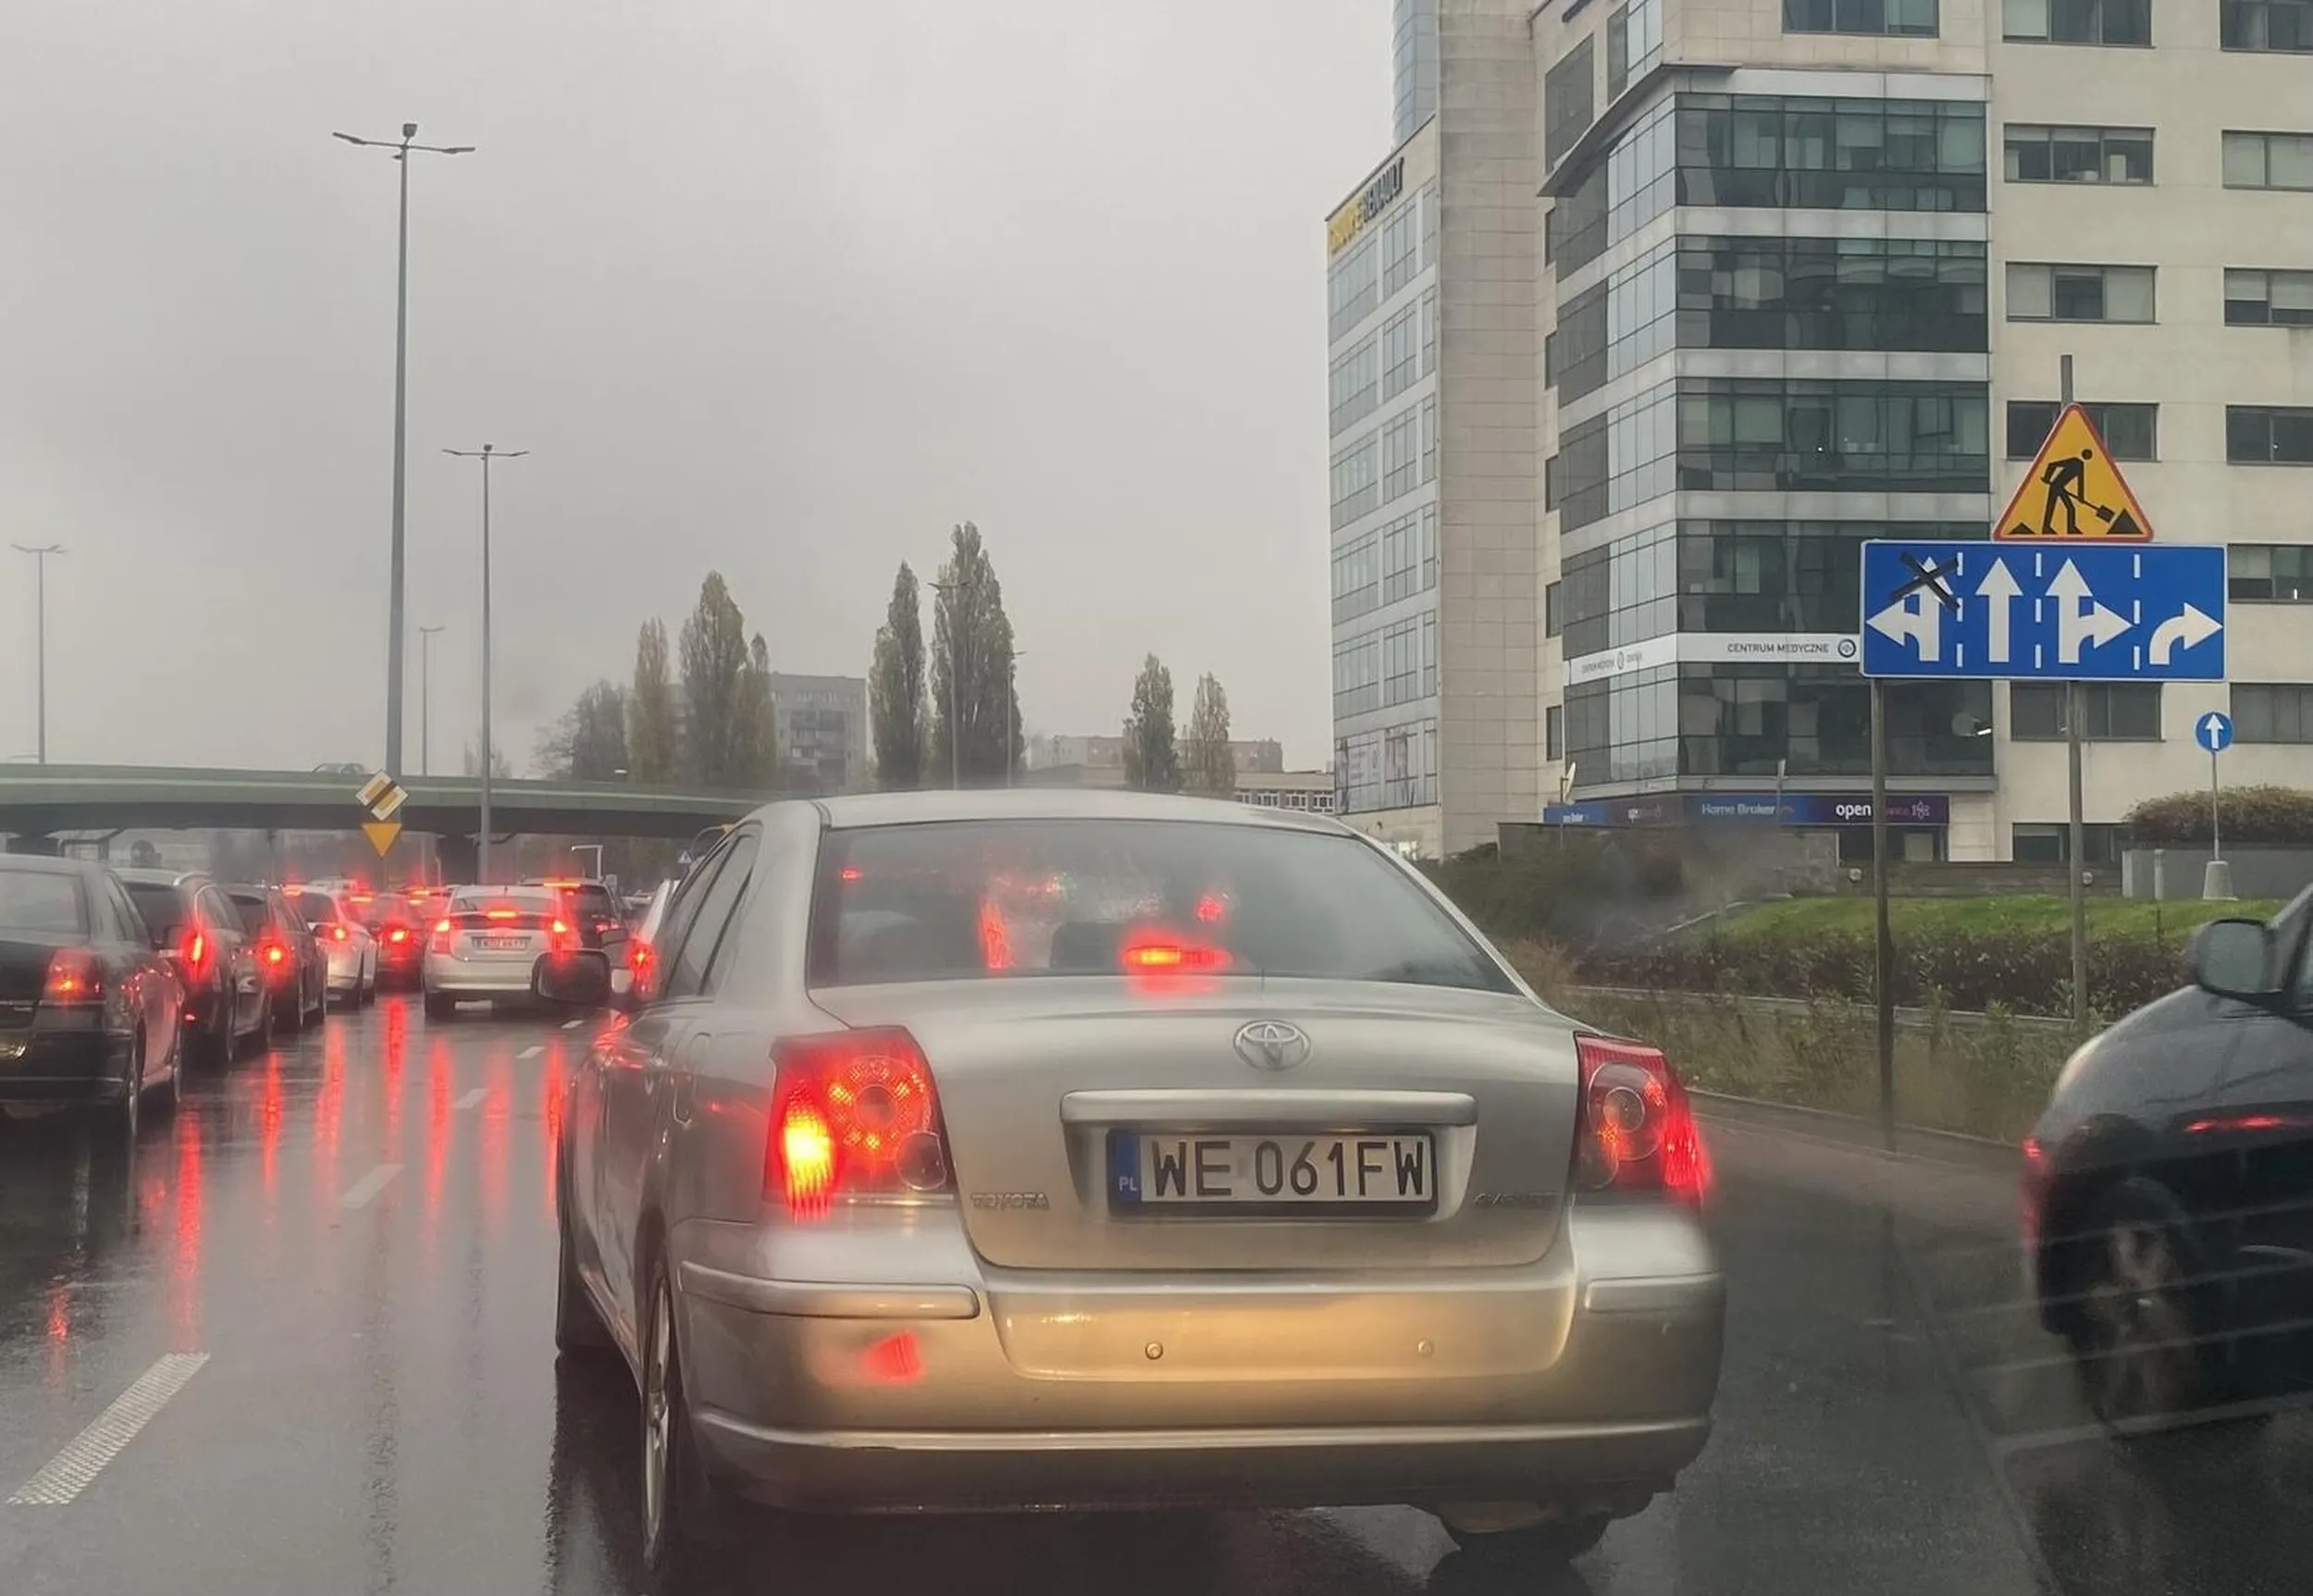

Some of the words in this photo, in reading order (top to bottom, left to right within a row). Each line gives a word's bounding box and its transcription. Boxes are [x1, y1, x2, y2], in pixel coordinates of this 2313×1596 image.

[1727, 643, 1775, 653] CENTRUM
[1776, 643, 1830, 653] MEDYCZNE
[1701, 803, 1736, 815] Home
[1737, 802, 1776, 815] Broker
[1836, 804, 1872, 821] open
[1151, 1140, 1232, 1197] WE
[1254, 1140, 1424, 1197] 061FW
[1118, 1175, 1138, 1192] PL
[971, 1192, 1050, 1210] TOYOTA
